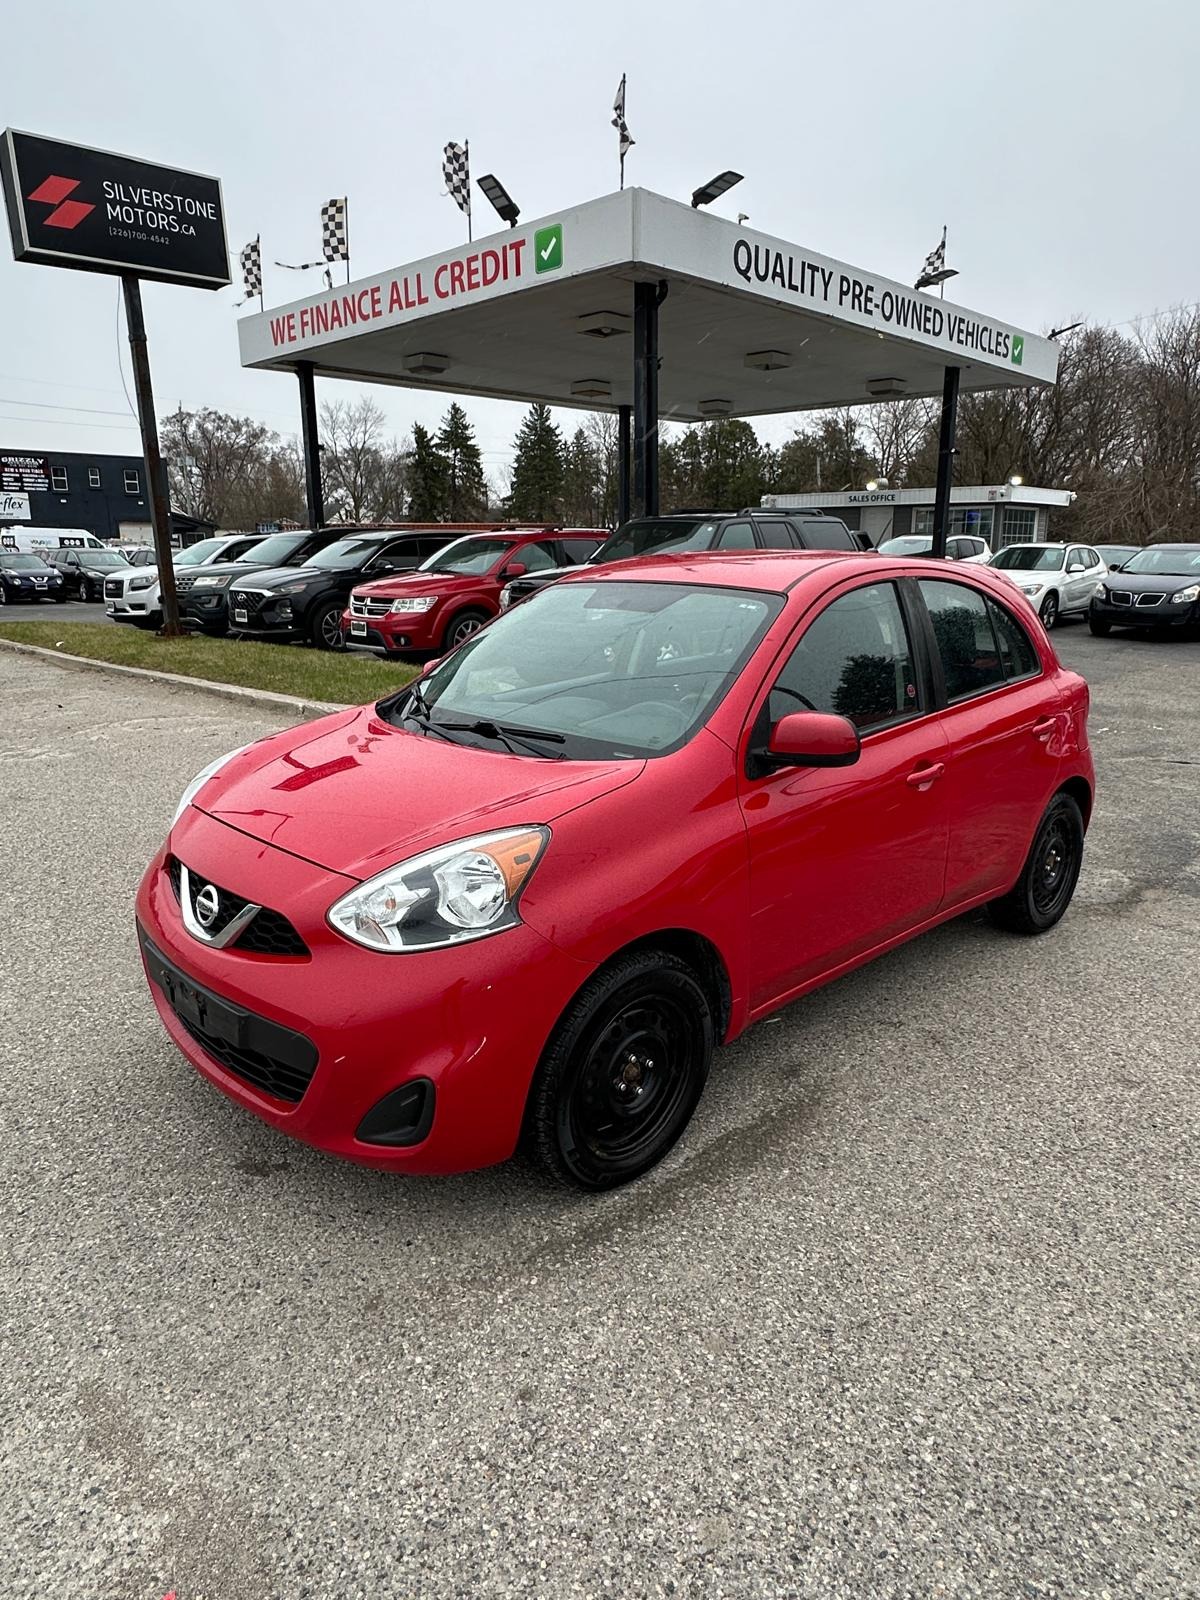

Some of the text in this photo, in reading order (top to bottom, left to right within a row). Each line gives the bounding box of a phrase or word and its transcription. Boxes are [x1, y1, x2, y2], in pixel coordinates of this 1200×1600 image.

[103, 181, 217, 220] SILVERSTONE
[270, 239, 526, 346] WE FINANCE ALL CREDIT
[733, 239, 1010, 359] QUALITY PRE-OWNED VEHICLES
[1, 456, 44, 464] GRIZZLY
[0, 496, 24, 512] flex
[848, 494, 896, 503] SALES OFFICE
